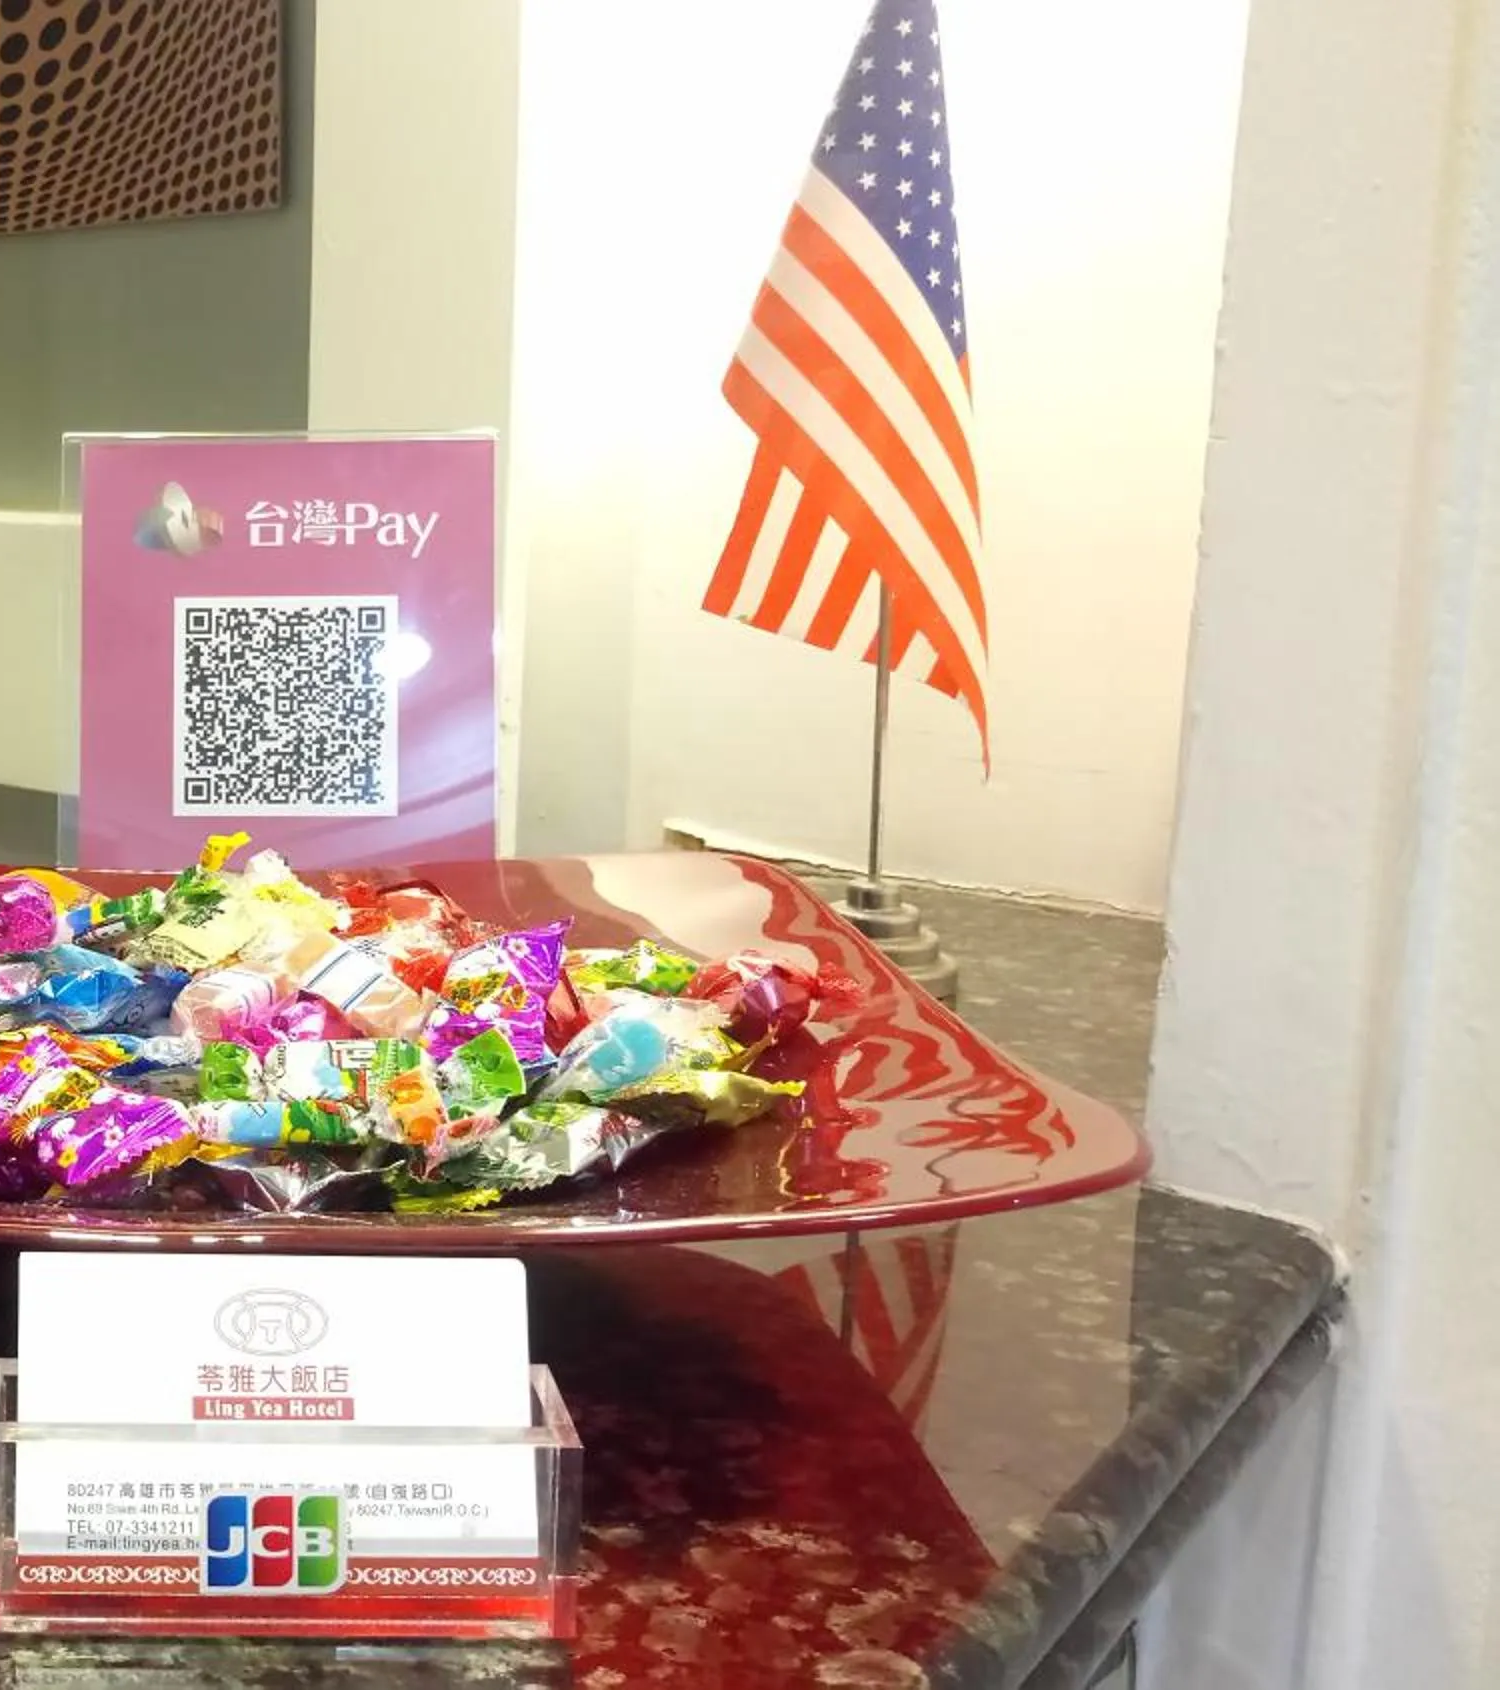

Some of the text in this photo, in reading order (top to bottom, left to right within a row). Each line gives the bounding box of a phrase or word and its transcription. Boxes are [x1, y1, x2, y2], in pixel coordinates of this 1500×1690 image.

[197, 1364, 350, 1393] 苓雅大飯店
[205, 1400, 343, 1418] Ling Yea Hotel
